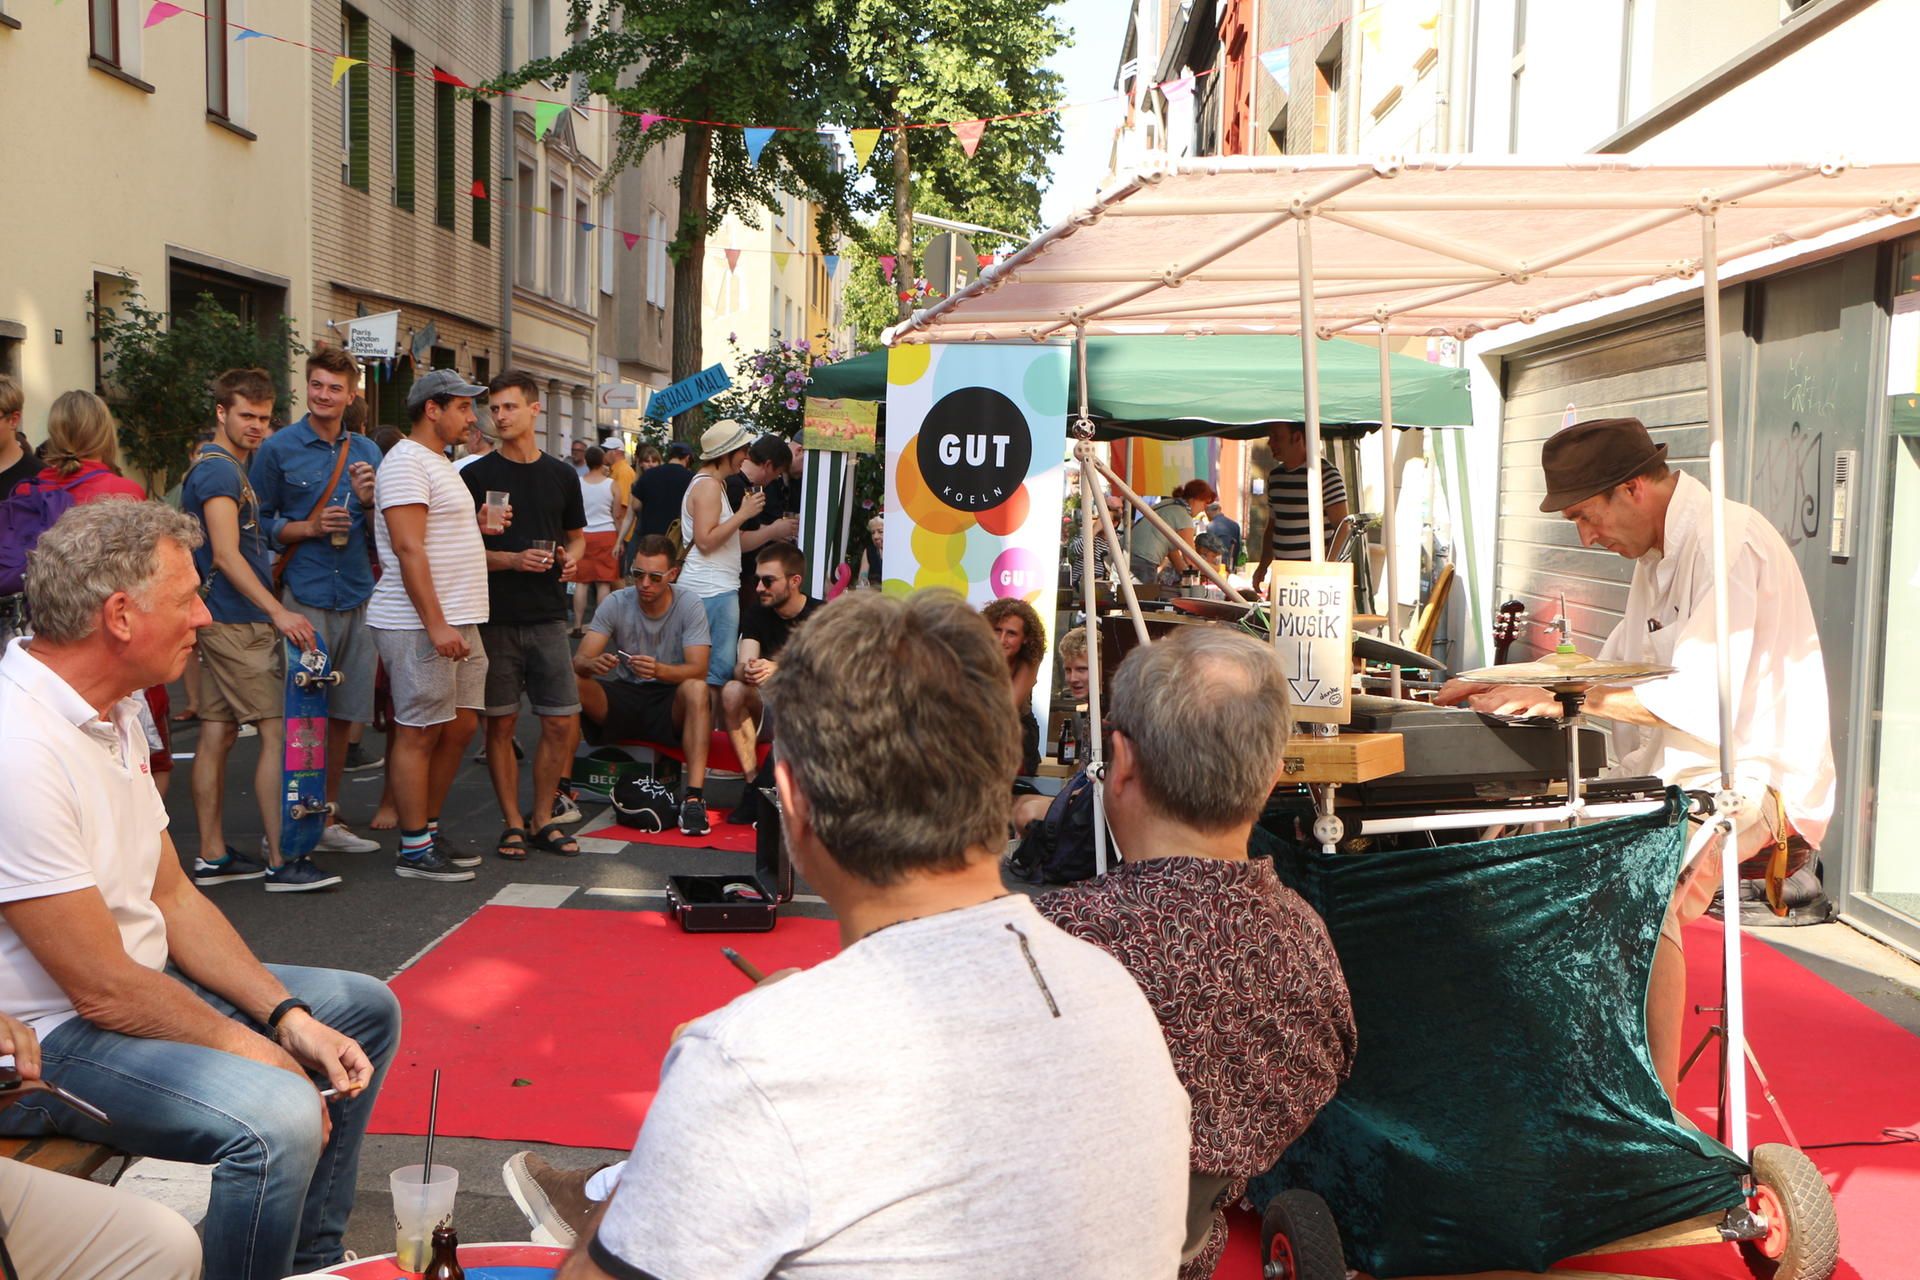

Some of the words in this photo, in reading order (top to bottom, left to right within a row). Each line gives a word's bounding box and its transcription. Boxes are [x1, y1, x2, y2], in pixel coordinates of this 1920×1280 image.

[352, 328, 371, 336] Paris
[352, 335, 380, 343] London
[352, 341, 374, 349] Tokyo
[654, 383, 694, 415] SCHAU
[938, 433, 1010, 468] GUT
[943, 485, 1003, 504] KOELN
[1000, 569, 1036, 587] GUT
[1278, 582, 1310, 607] FÜR
[588, 774, 619, 785] BEC
